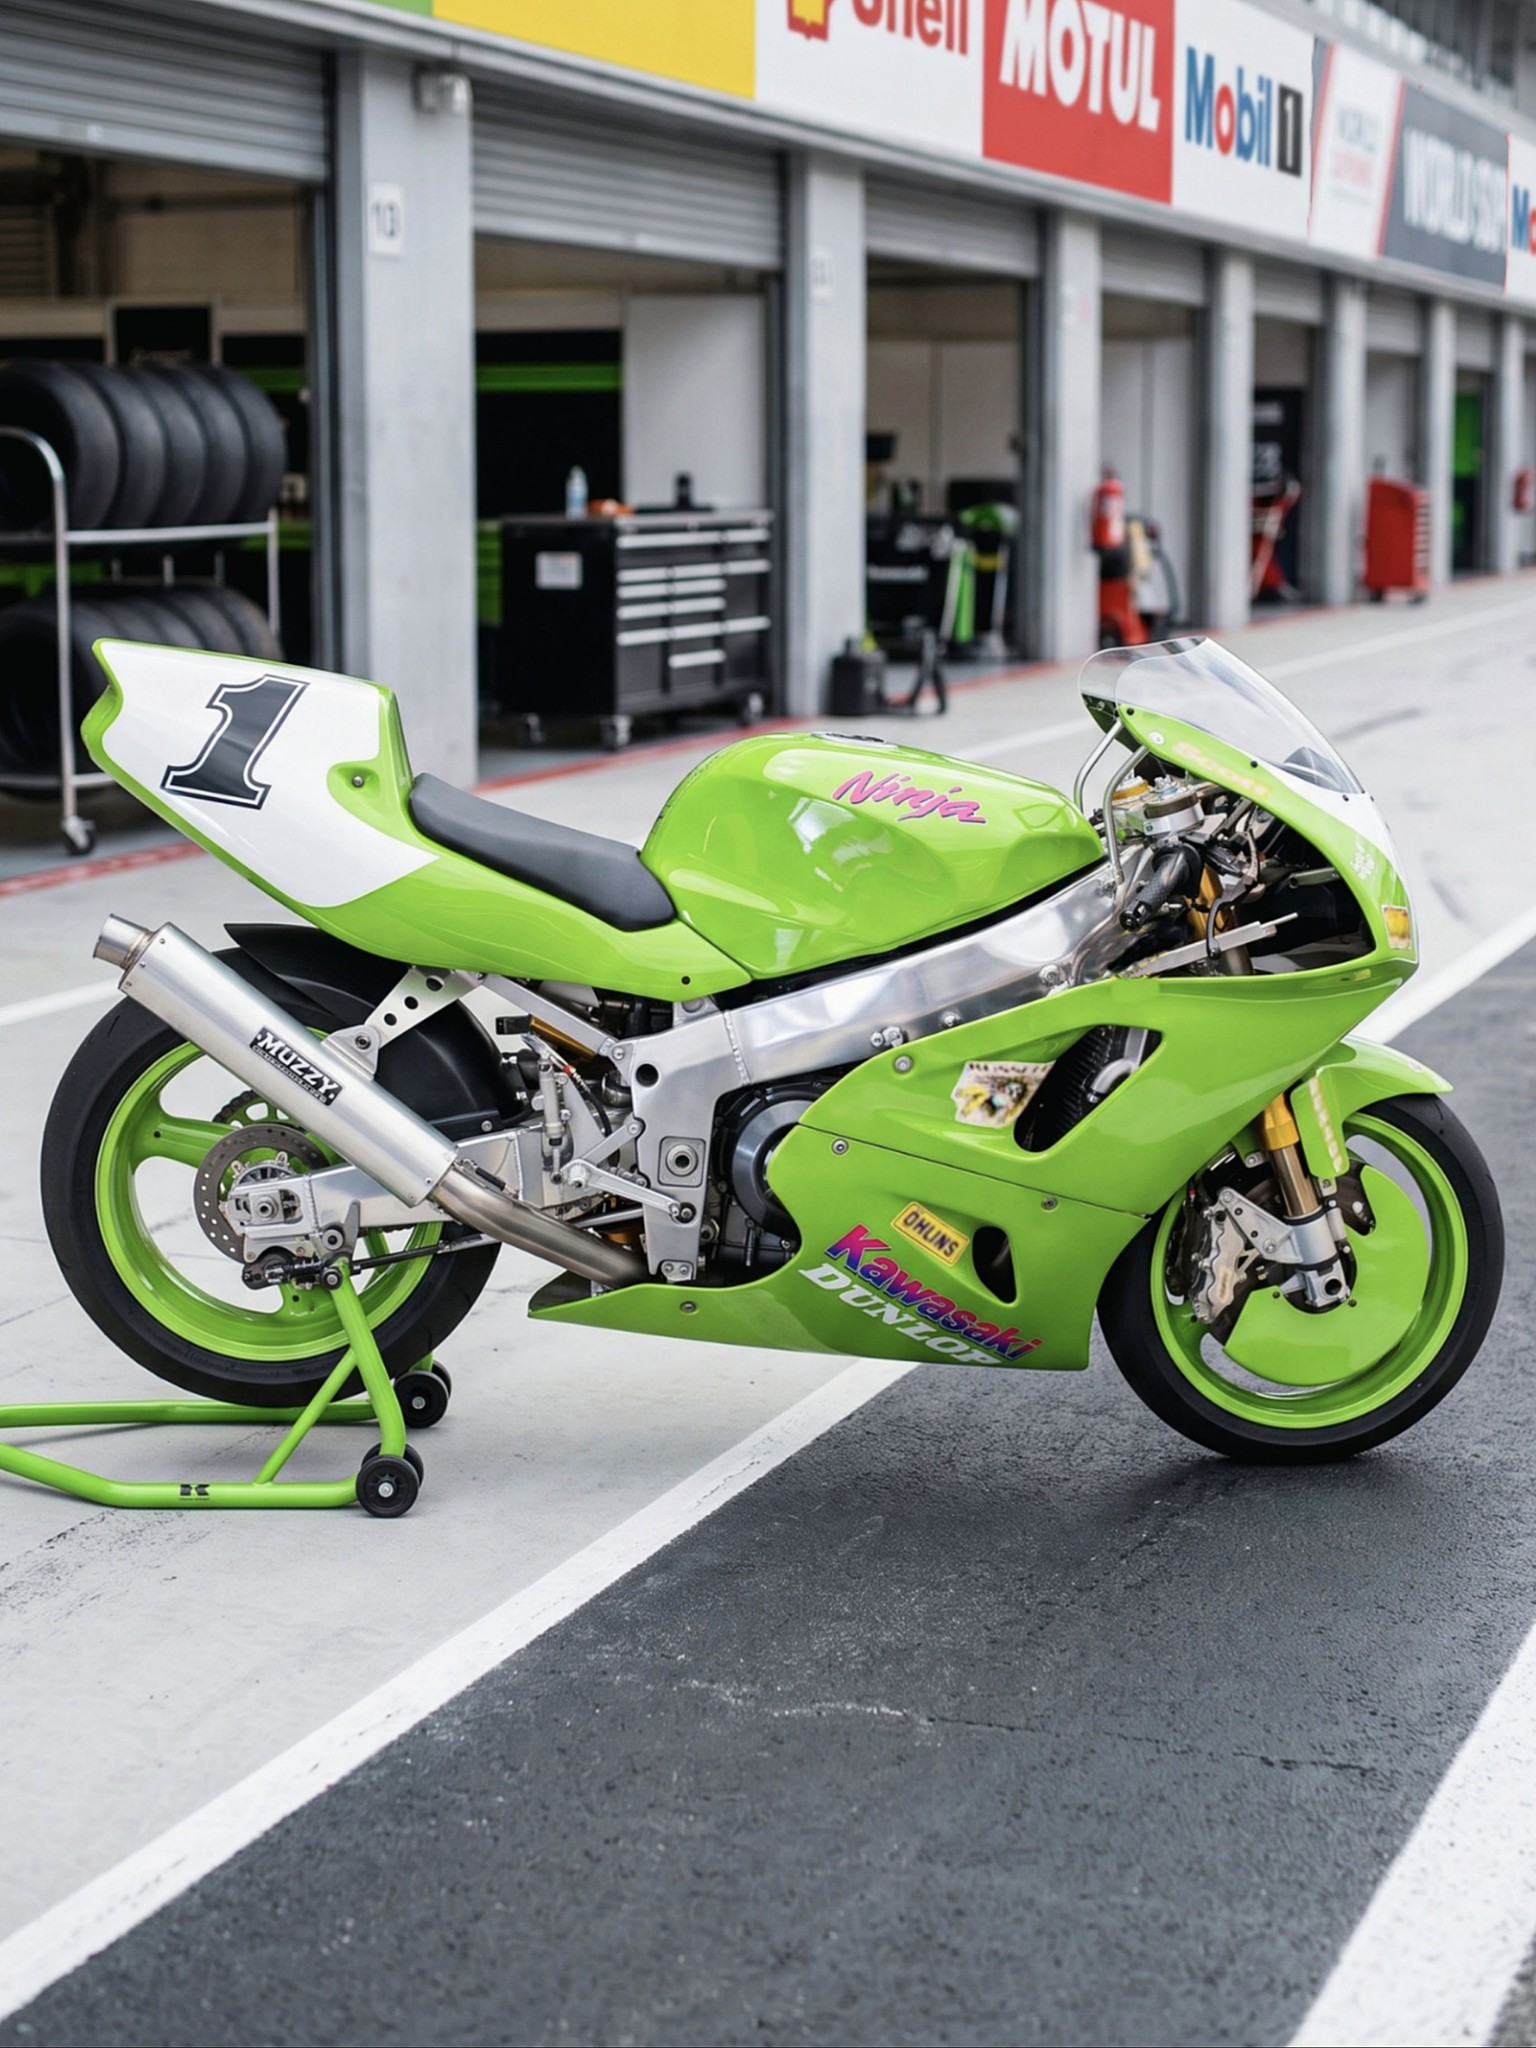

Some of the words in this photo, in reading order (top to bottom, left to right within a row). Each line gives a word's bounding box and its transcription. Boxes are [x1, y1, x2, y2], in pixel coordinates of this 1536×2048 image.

[1000, 0, 1160, 132] MOTUL
[1186, 46, 1272, 168] Mobil
[161, 674, 310, 810] 1
[832, 770, 986, 824] Ninja
[258, 1031, 339, 1094] MUZZY
[799, 1263, 1001, 1364] DUNLOP
[825, 1224, 1043, 1360] Kawasaki
